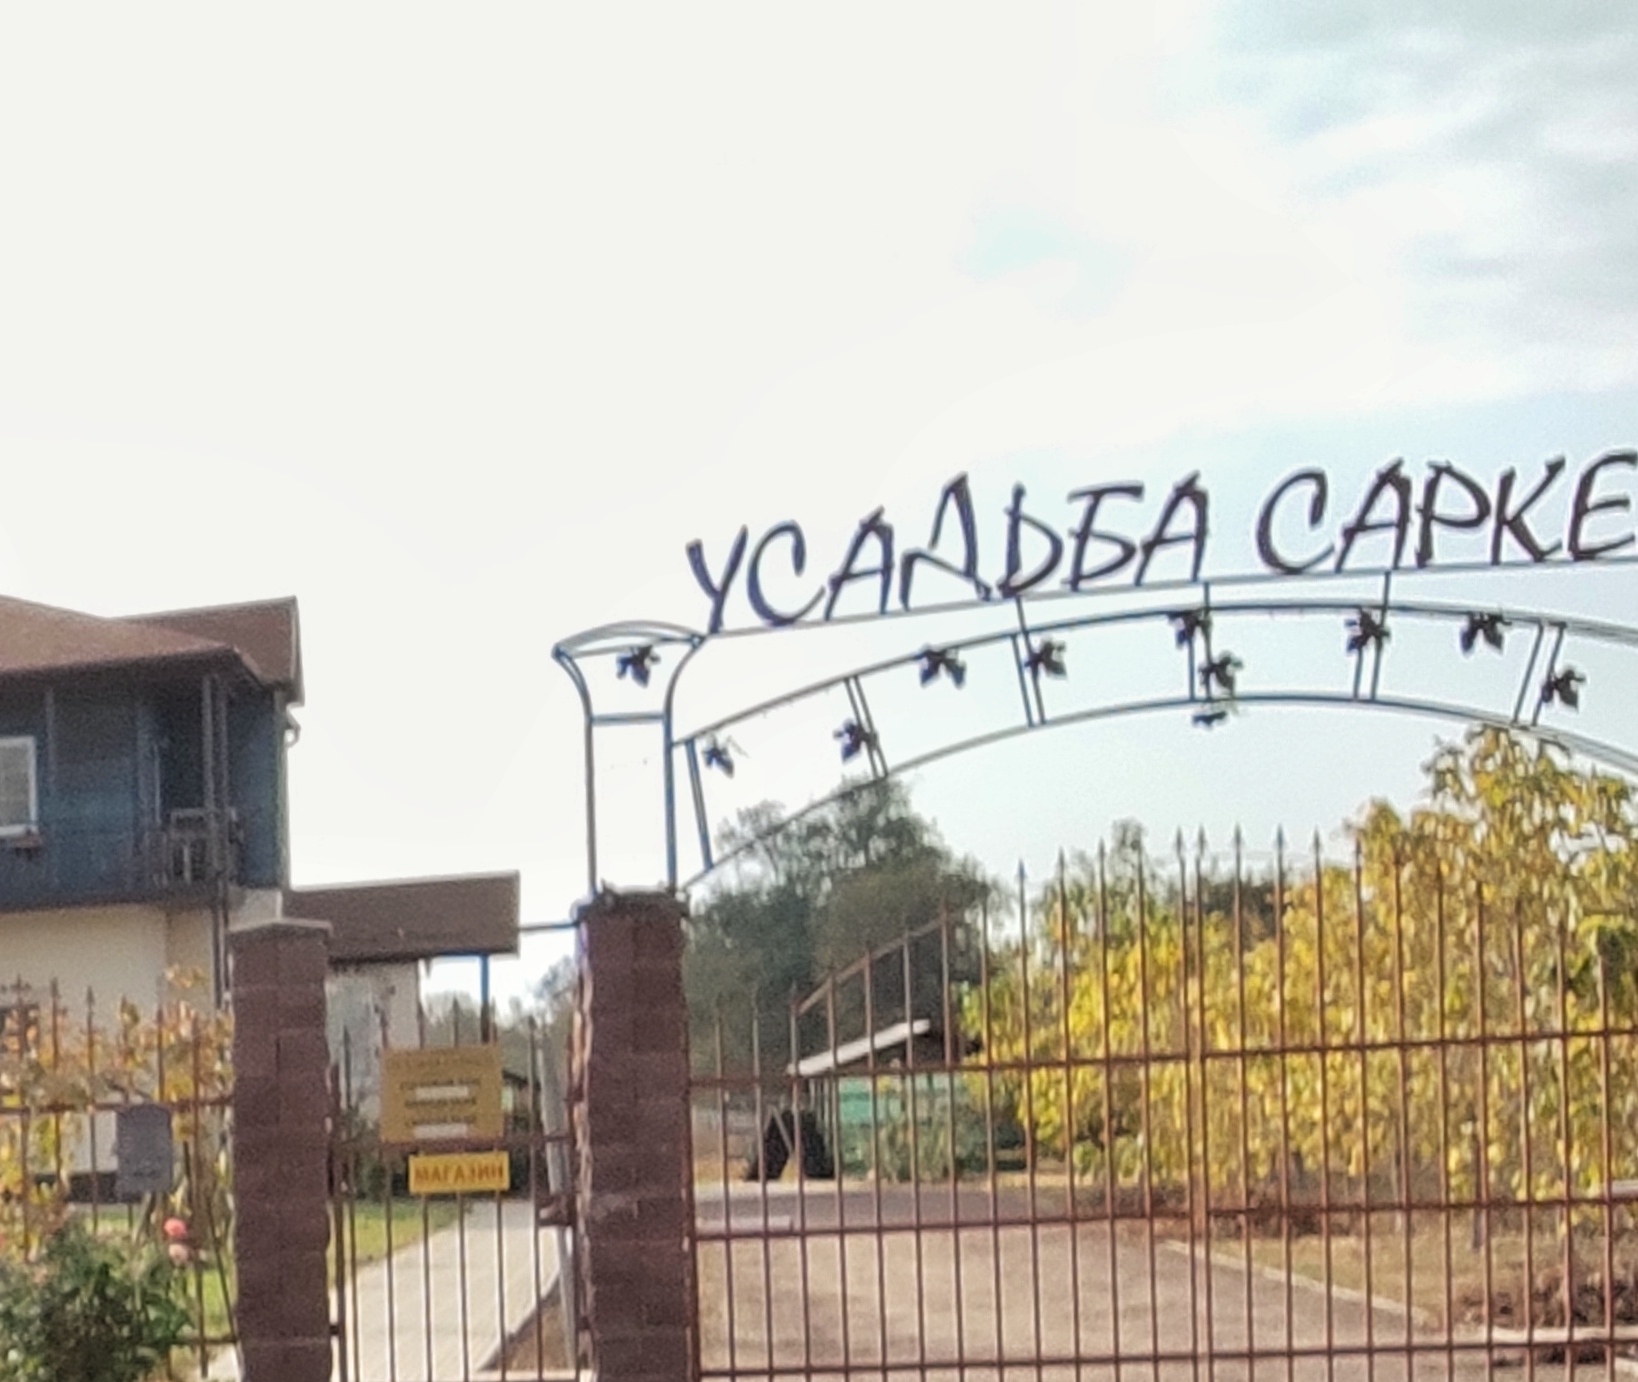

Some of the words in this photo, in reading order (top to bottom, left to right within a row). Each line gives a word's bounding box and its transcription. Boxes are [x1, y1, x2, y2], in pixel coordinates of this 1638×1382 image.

[686, 470, 1210, 635] УСАДЬБА
[1254, 448, 1638, 574] САРКЕ
[413, 1163, 504, 1184] МАГАЗИН
